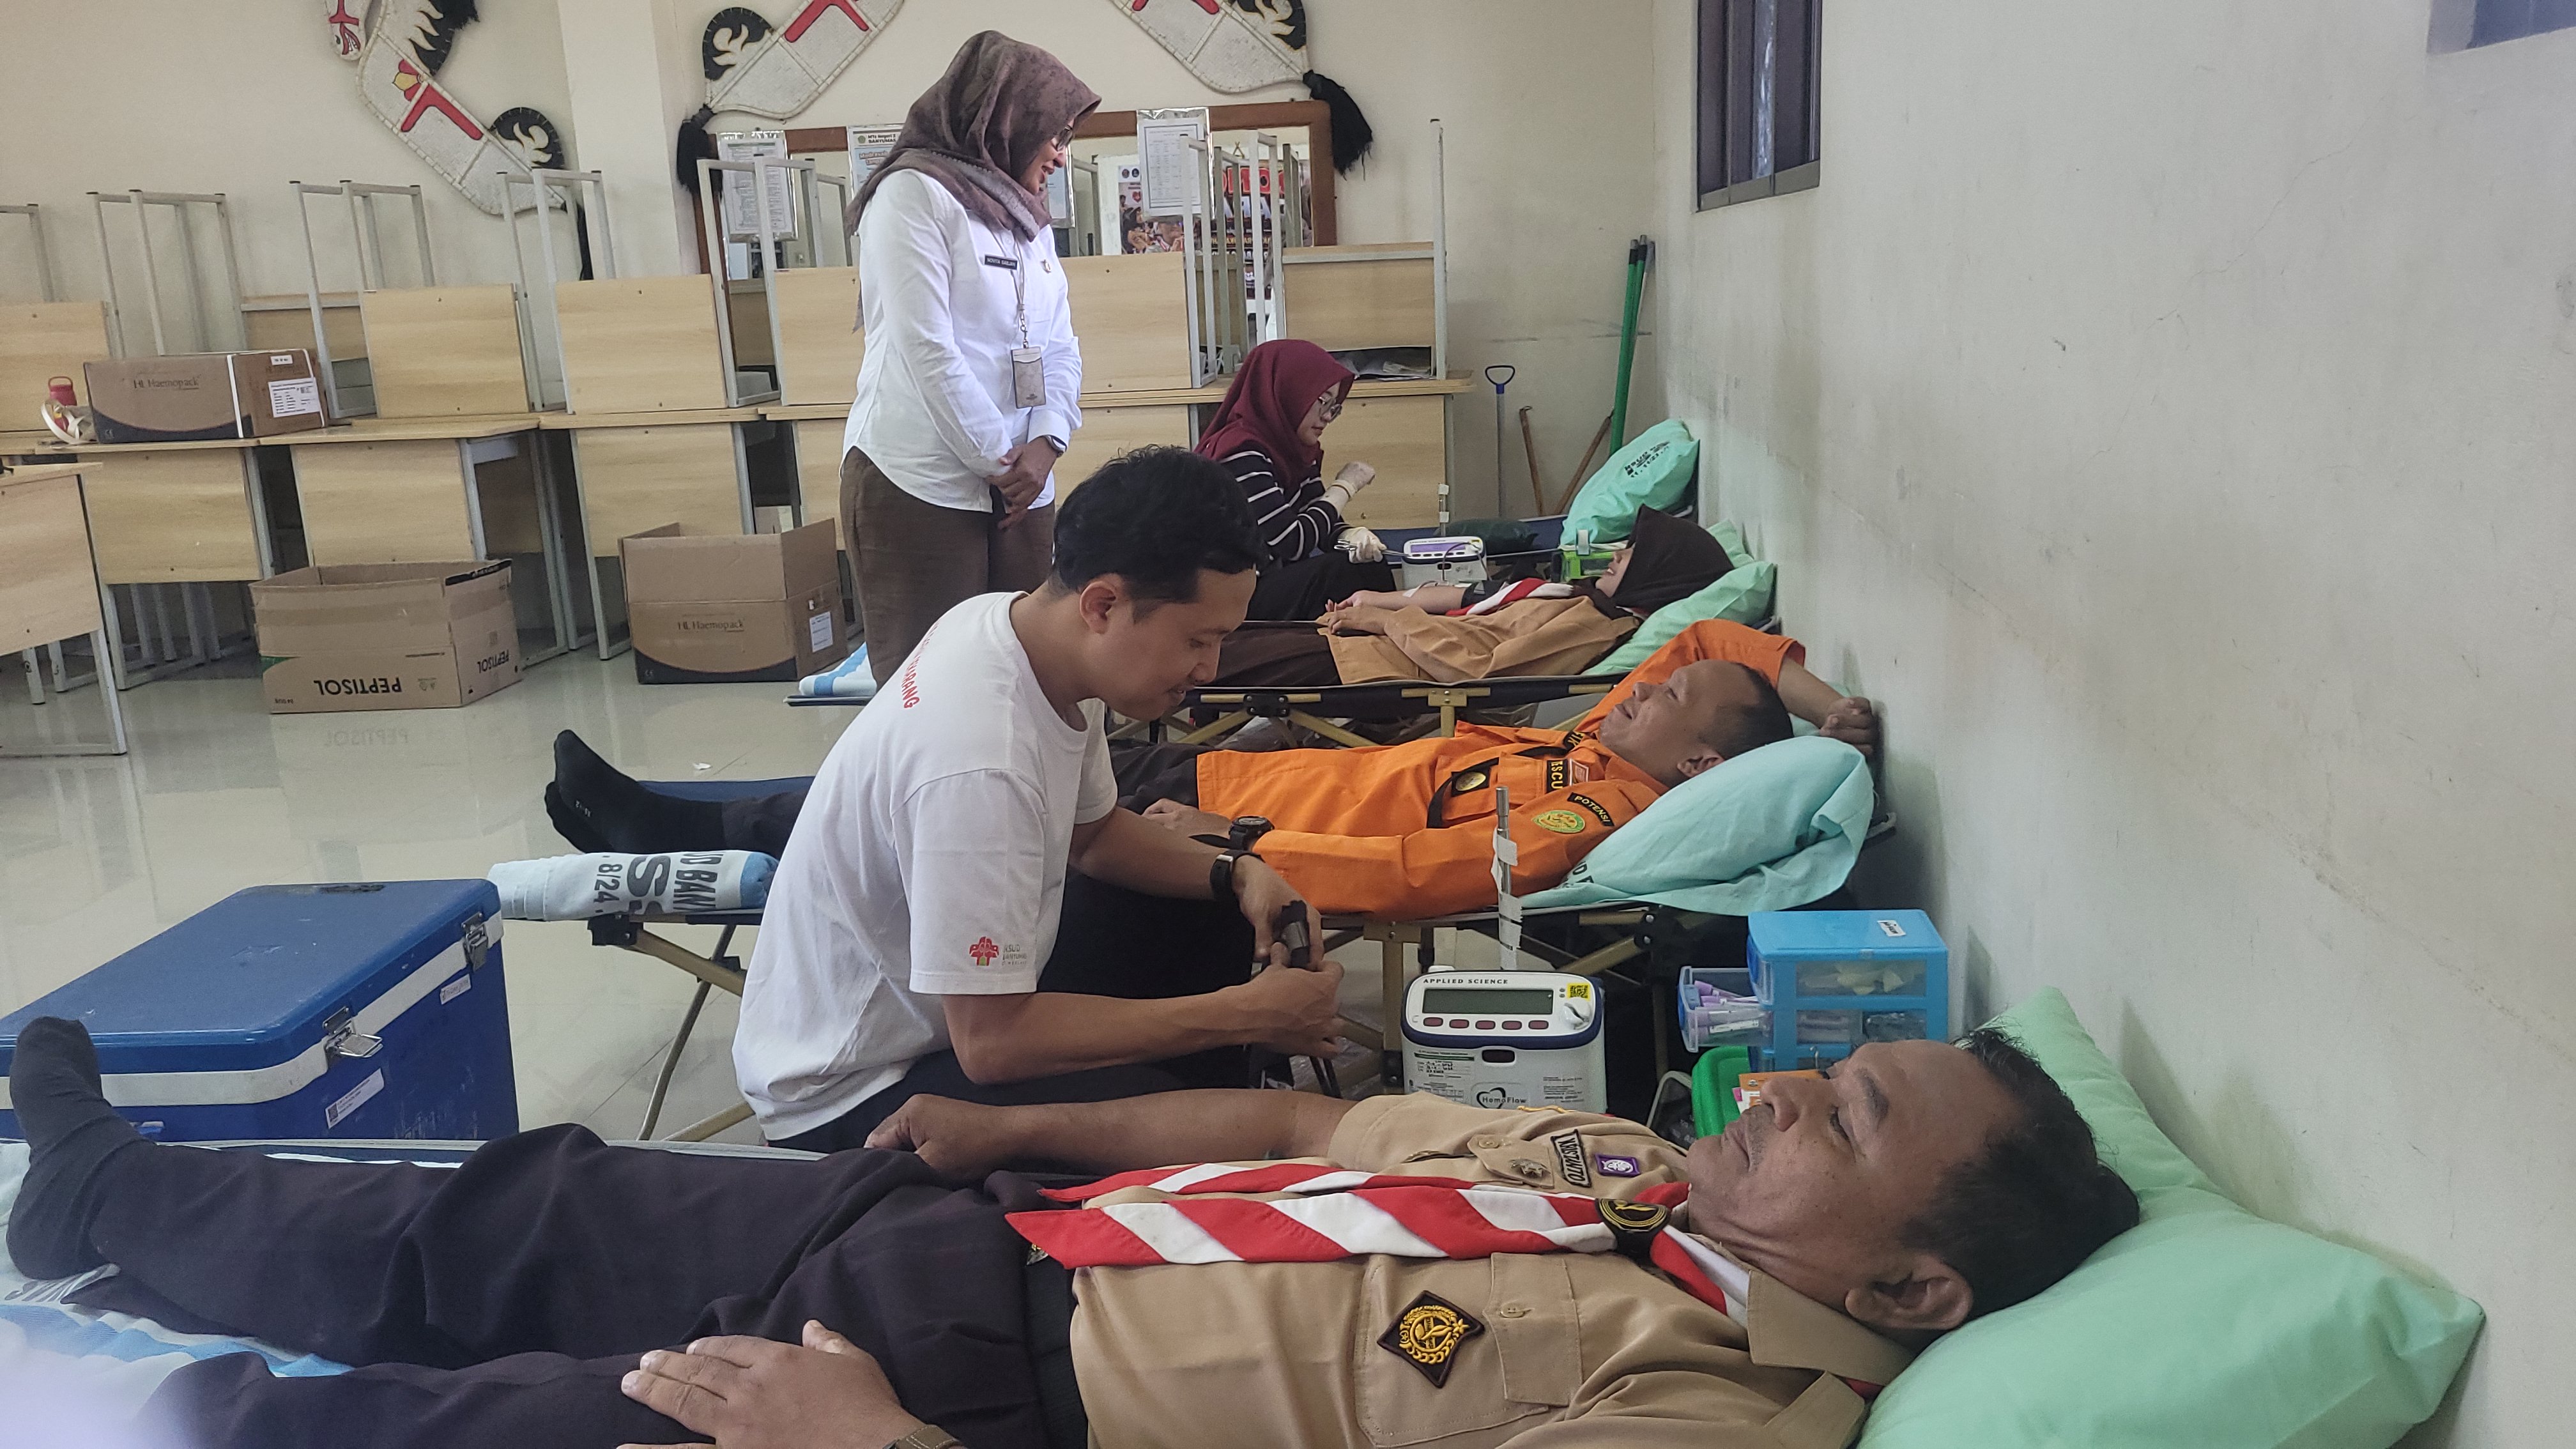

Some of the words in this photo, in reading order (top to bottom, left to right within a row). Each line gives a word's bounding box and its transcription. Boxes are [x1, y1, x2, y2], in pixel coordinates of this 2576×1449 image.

[477, 650, 510, 673] PEPTISOL
[313, 677, 402, 696] PEPTISOL
[1574, 795, 1611, 823] POTENSI
